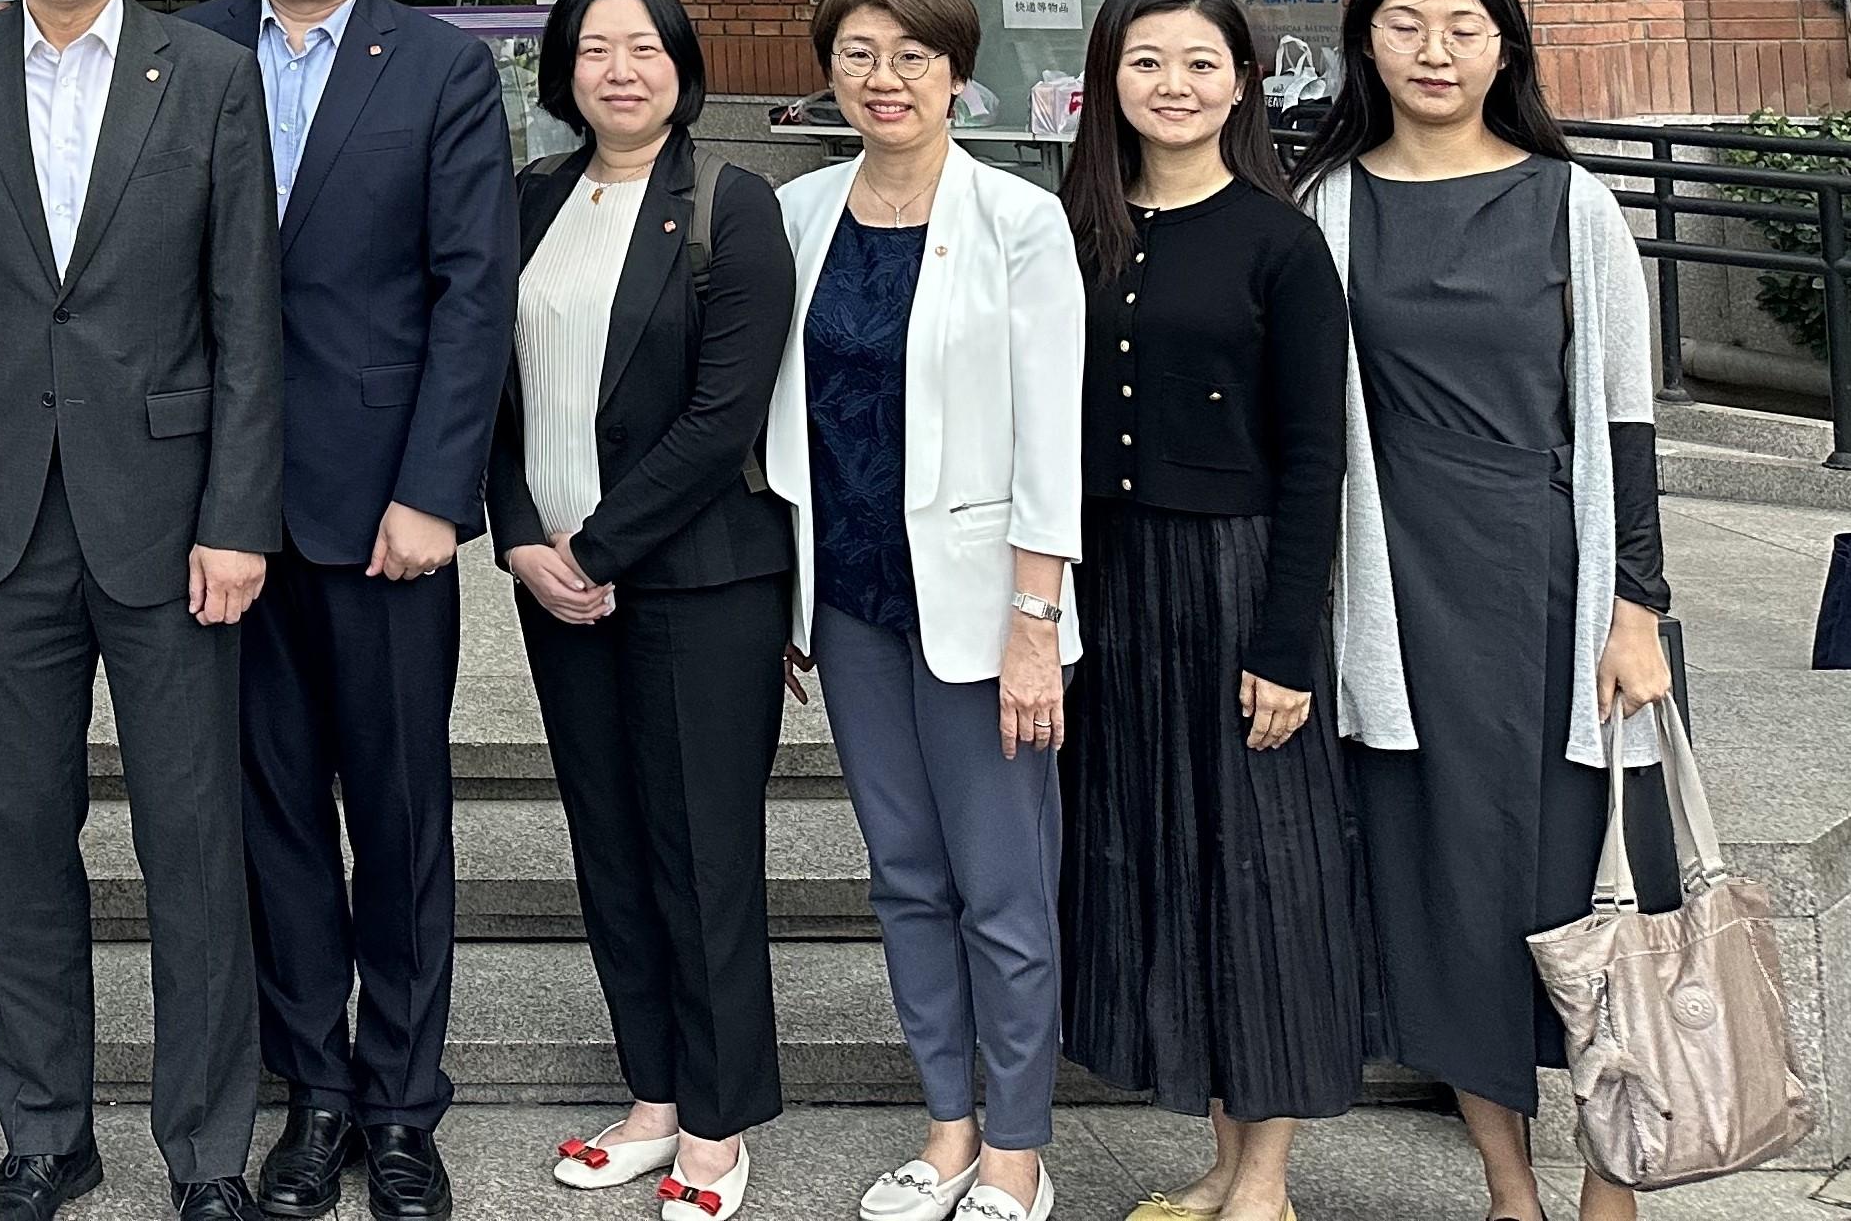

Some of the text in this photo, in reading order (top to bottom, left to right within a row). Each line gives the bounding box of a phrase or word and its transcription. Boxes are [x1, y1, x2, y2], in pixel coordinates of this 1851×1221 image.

[1015, 2, 1069, 13] 快递等物品
